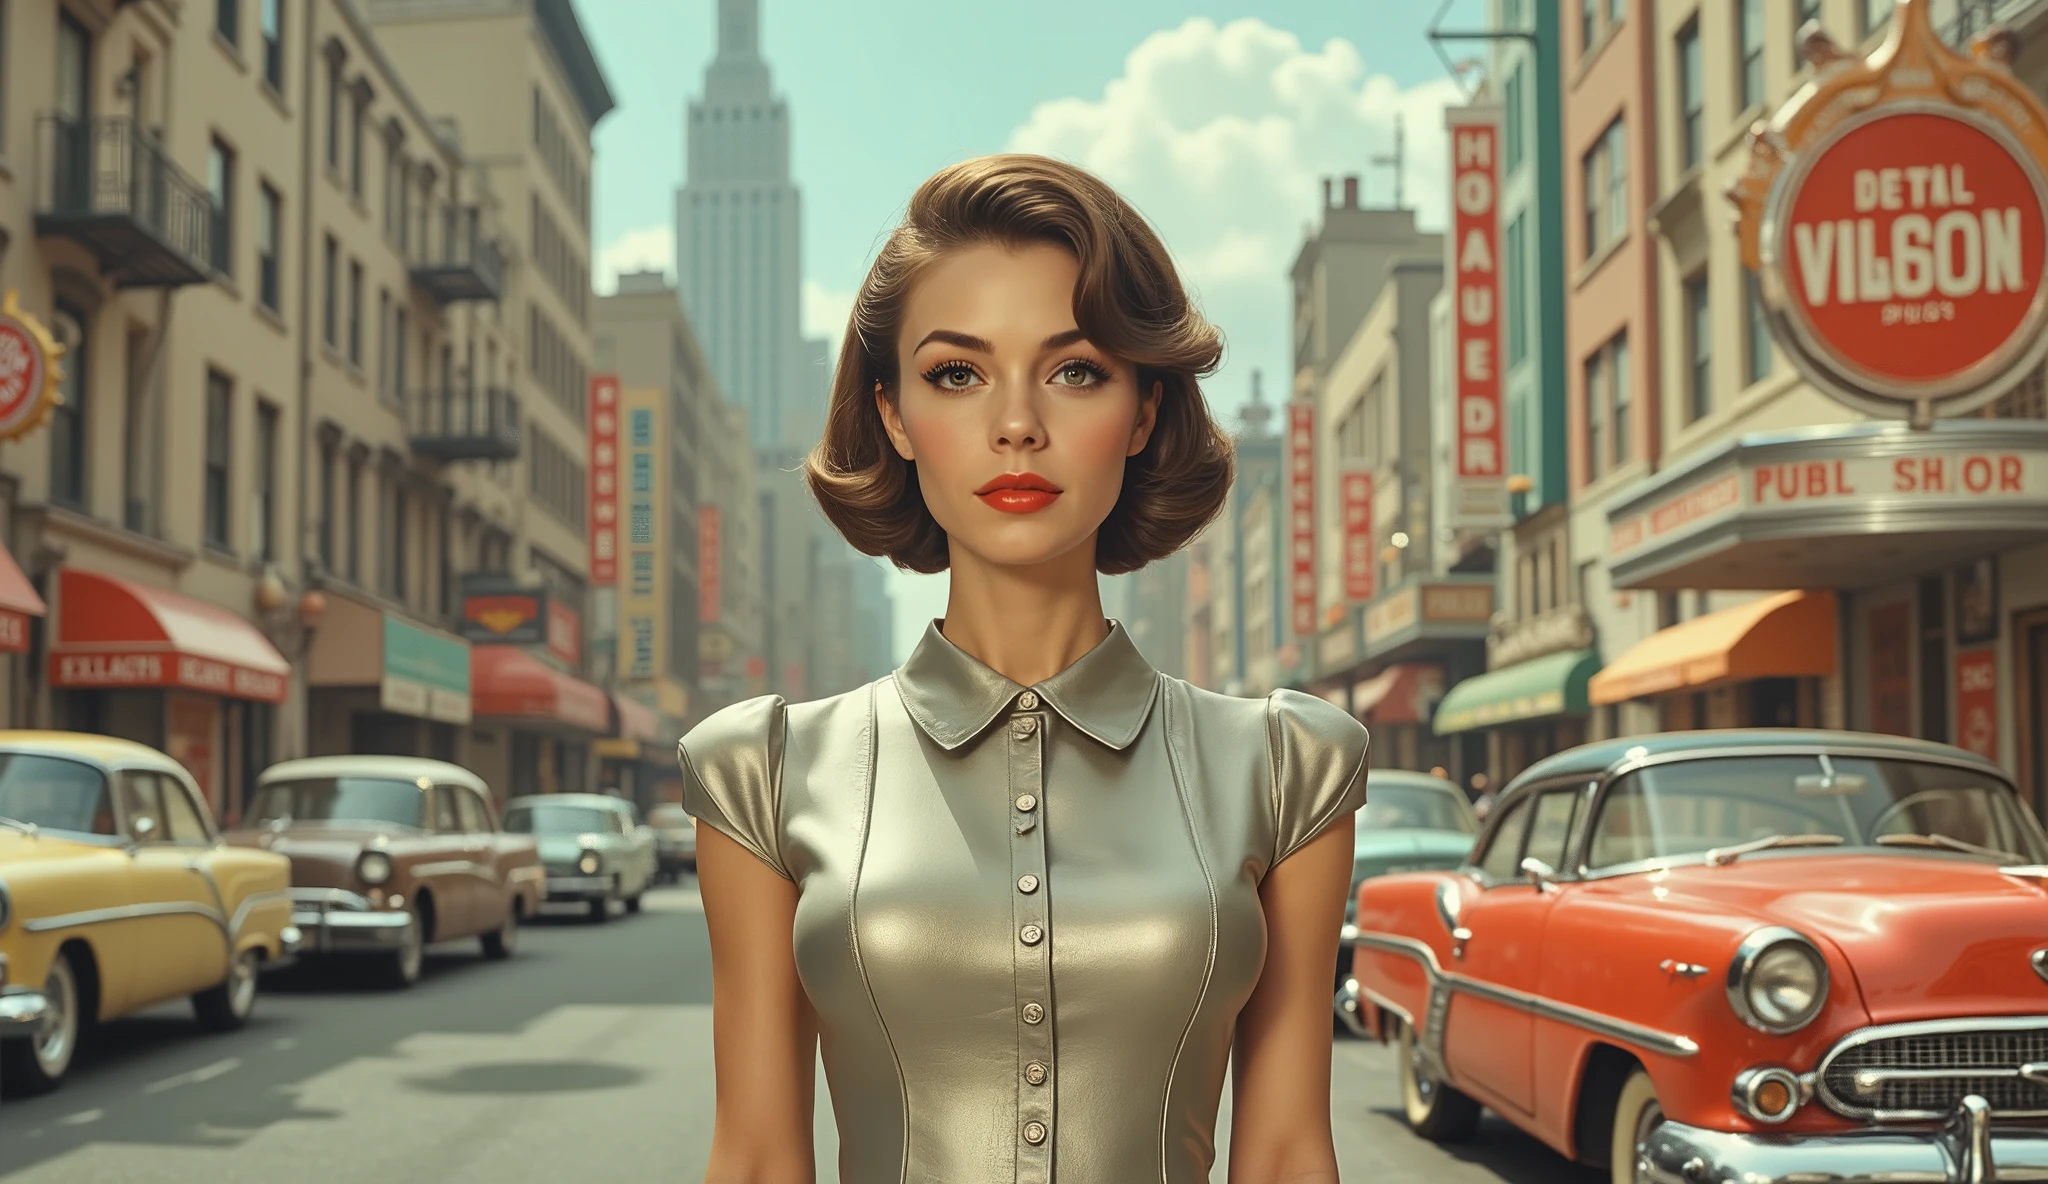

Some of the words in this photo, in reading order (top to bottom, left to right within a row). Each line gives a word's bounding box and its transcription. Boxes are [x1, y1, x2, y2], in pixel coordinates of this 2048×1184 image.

[1854, 163, 1975, 213] DETAL
[1457, 131, 1496, 474] HOAUEDR
[1755, 459, 1854, 503] PUBL
